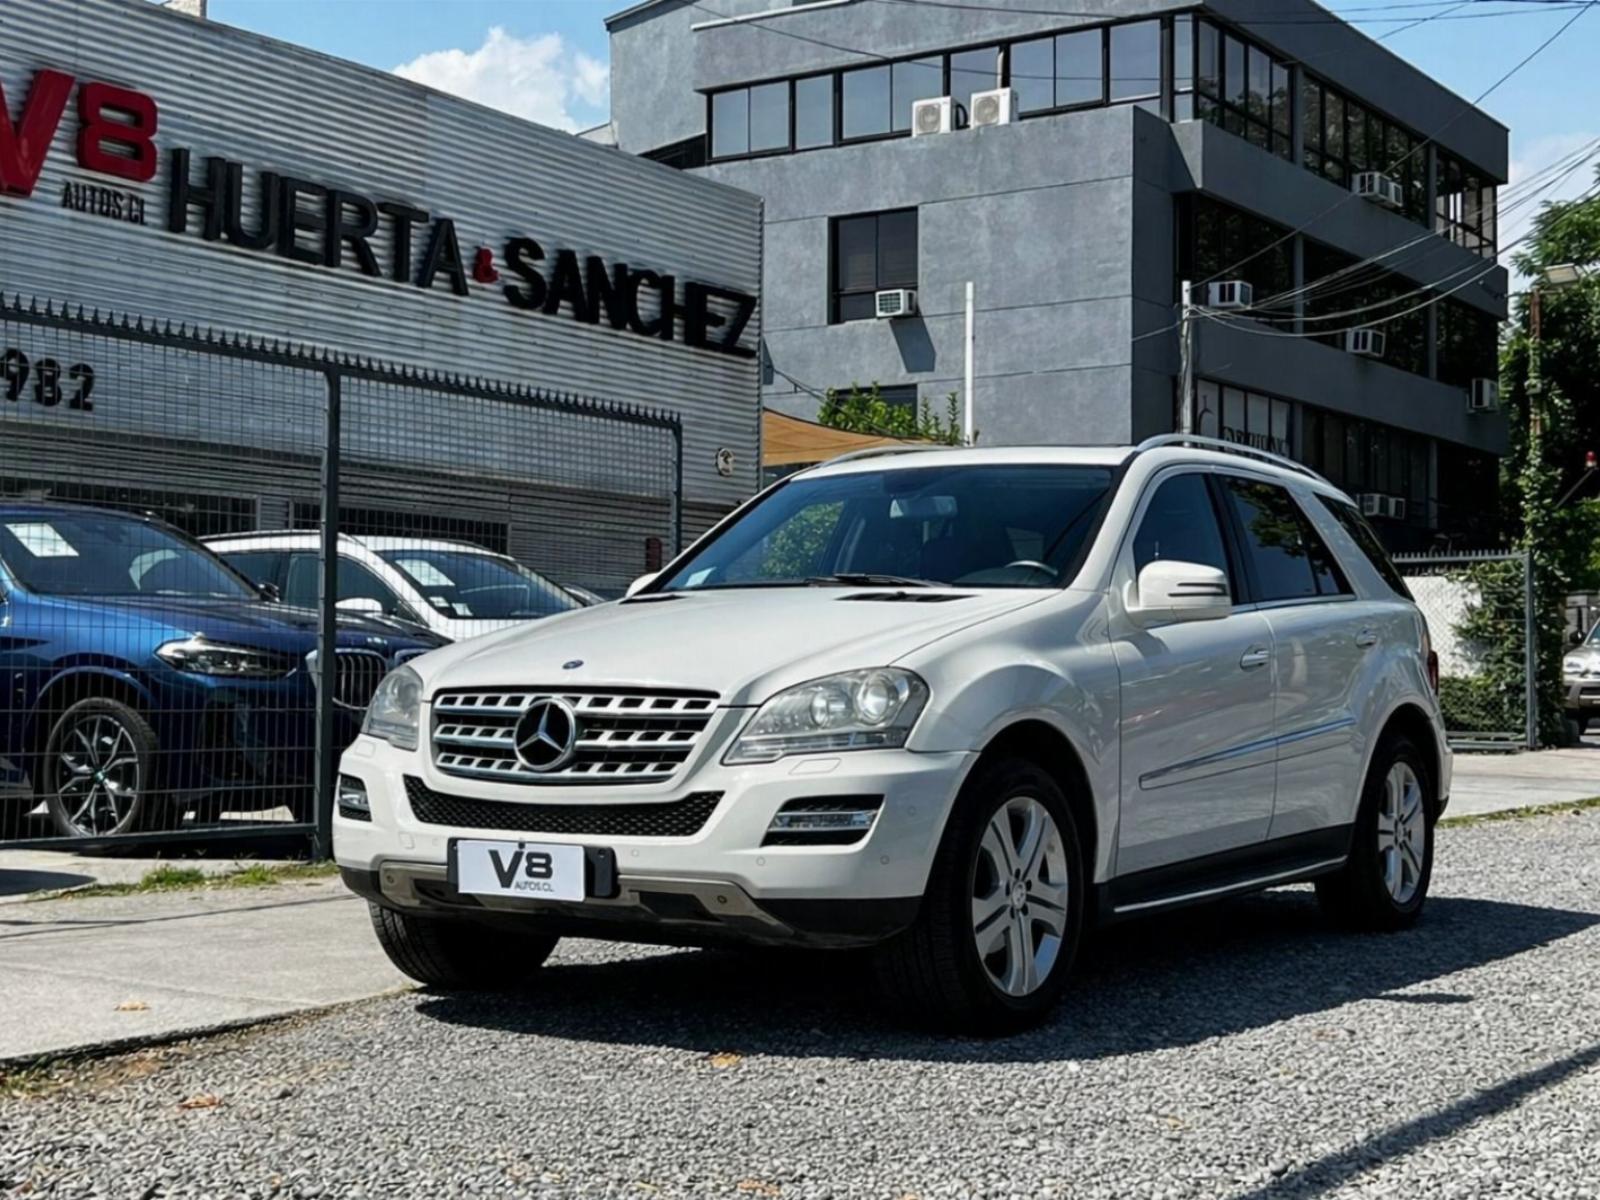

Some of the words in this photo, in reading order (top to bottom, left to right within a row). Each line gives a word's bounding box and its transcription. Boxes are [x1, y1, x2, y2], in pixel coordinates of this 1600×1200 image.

[0, 68, 158, 197] V8
[62, 181, 147, 225] AUTOS.CL
[169, 147, 469, 296] HUERTA
[474, 247, 498, 283] &
[503, 236, 758, 358] SANCHEZ
[489, 850, 553, 888] V8
